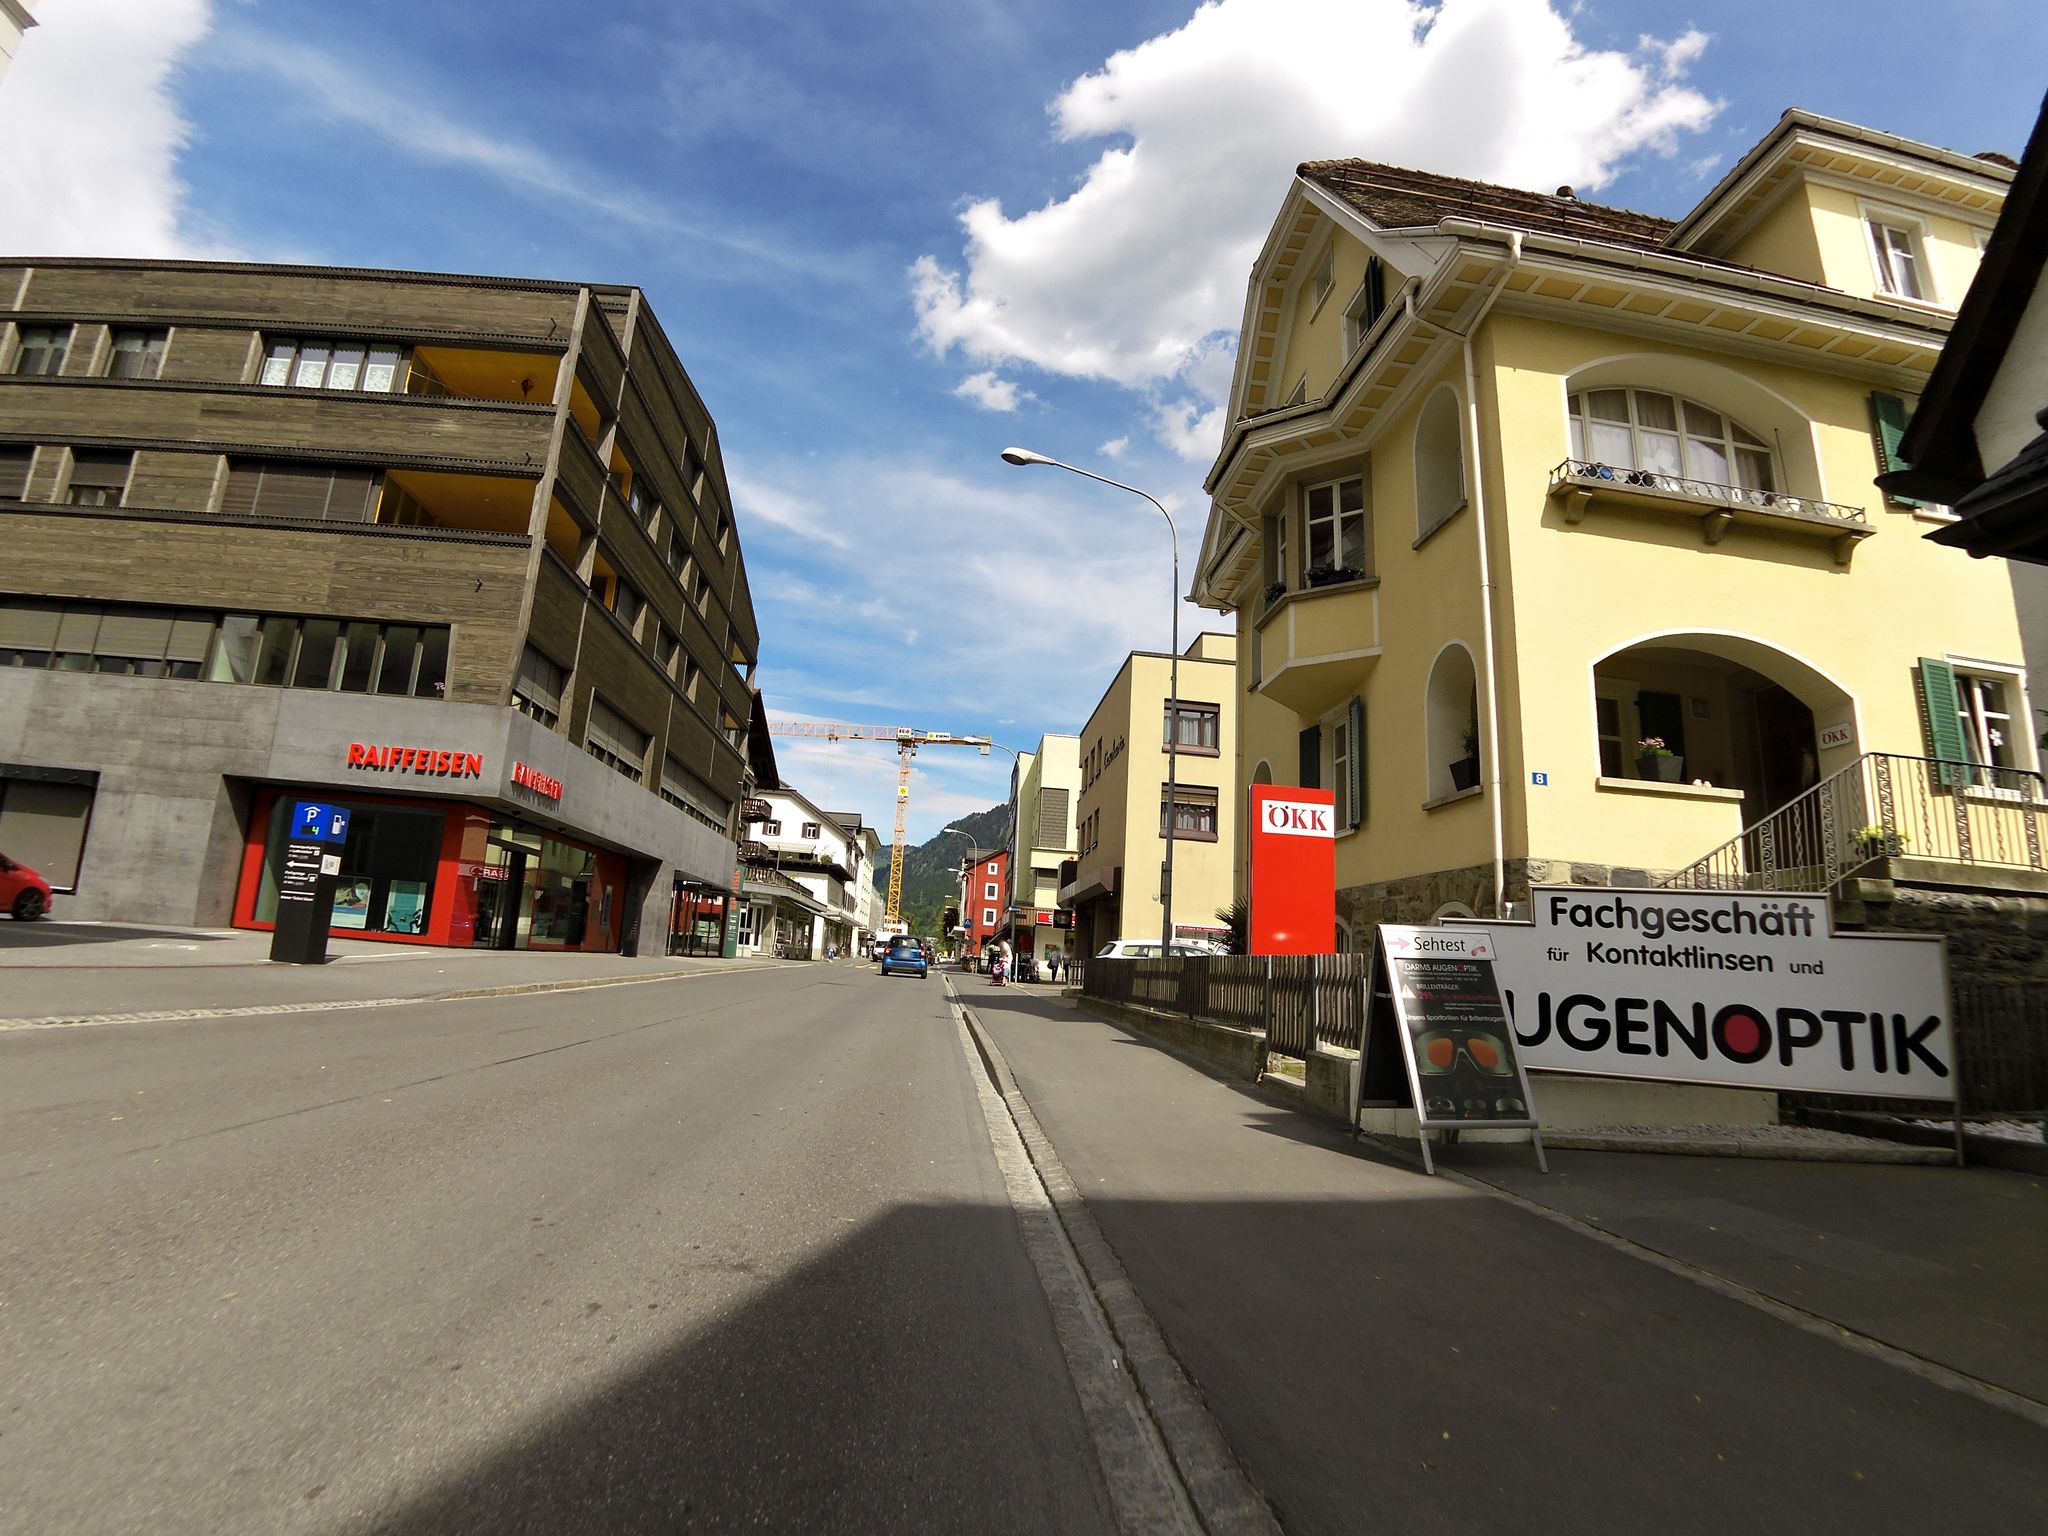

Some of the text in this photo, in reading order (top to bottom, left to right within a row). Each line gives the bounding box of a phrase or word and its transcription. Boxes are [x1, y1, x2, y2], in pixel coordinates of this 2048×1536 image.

[347, 743, 483, 776] RAIFFEISEN
[1536, 774, 1544, 784] 8
[306, 809, 317, 823] P
[1268, 804, 1328, 831] ÖKK
[1550, 896, 1815, 938] Fachgeschäft
[1414, 937, 1466, 952] Sehtest
[1404, 963, 1478, 972] DARMS AUGENOPTIK
[1546, 942, 1824, 976] für Kontaktlinsen und
[1505, 989, 1949, 1078] UGENOPTIK
